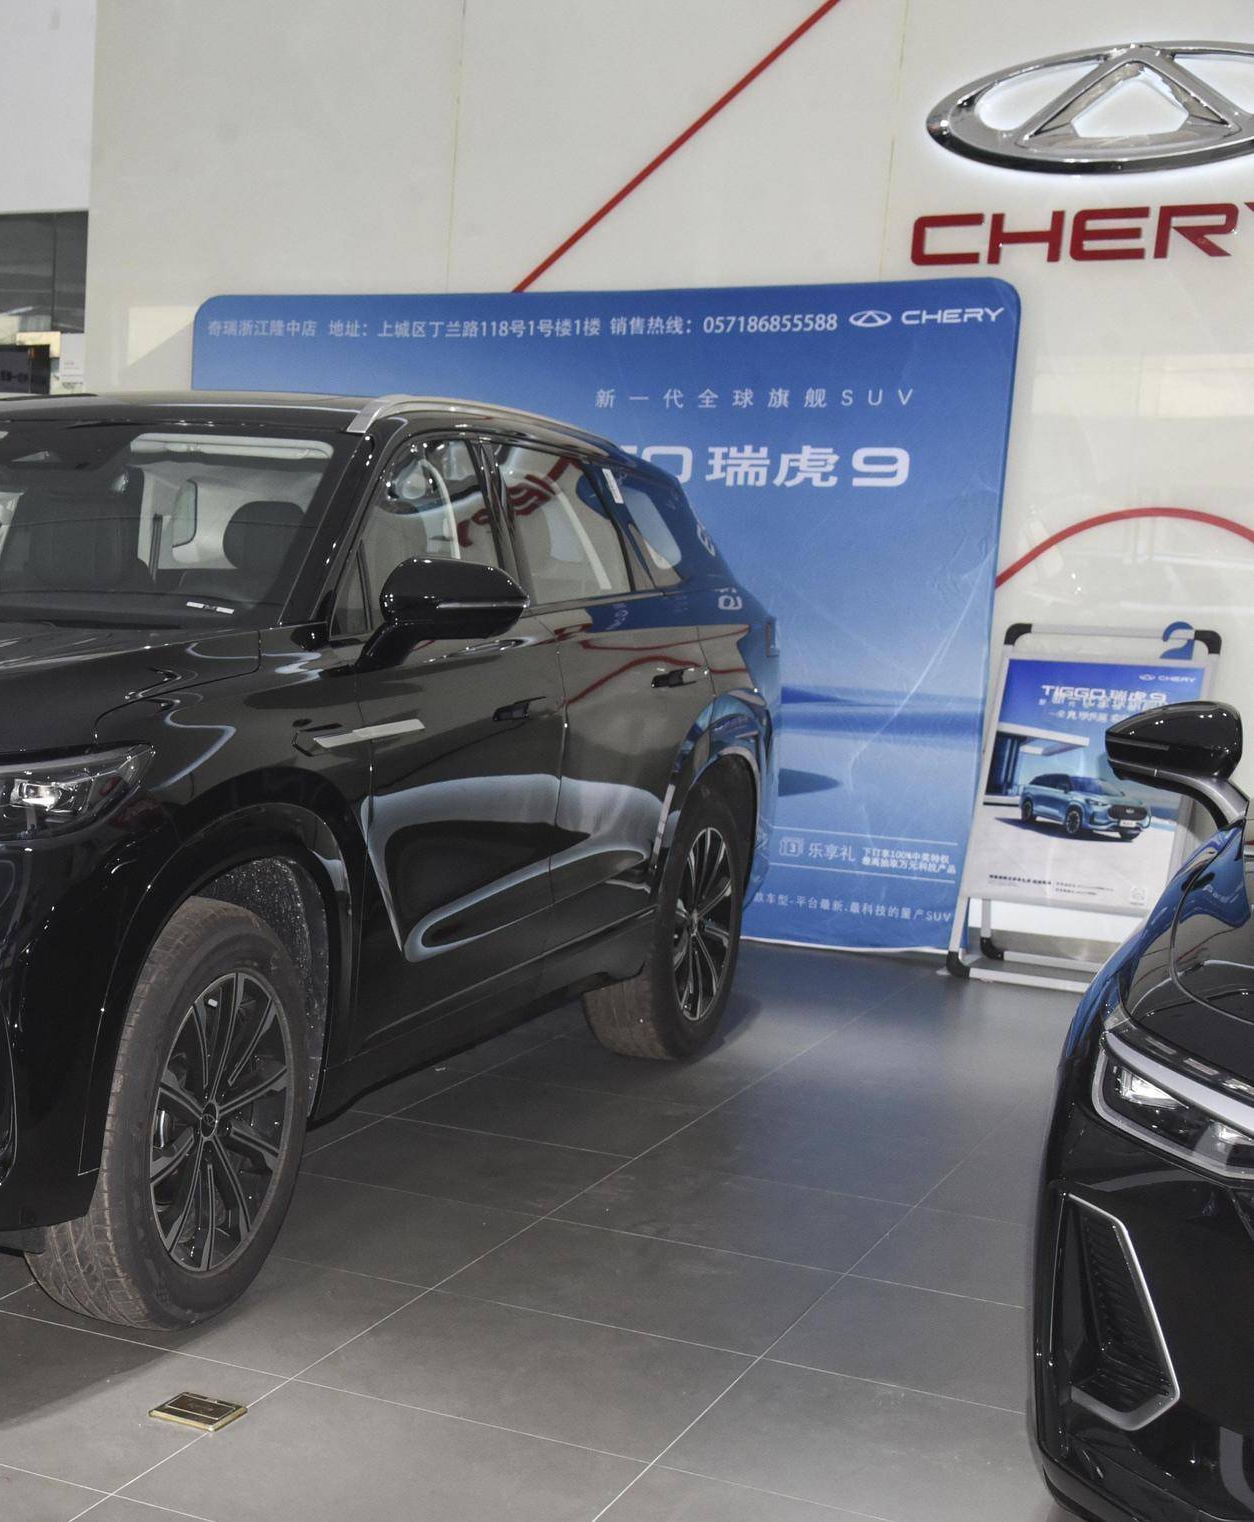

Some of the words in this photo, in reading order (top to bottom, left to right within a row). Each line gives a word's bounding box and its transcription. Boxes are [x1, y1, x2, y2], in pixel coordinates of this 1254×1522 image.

[911, 200, 1254, 266] CHER
[703, 313, 838, 334] 057186855588
[901, 307, 1004, 325] CHERY
